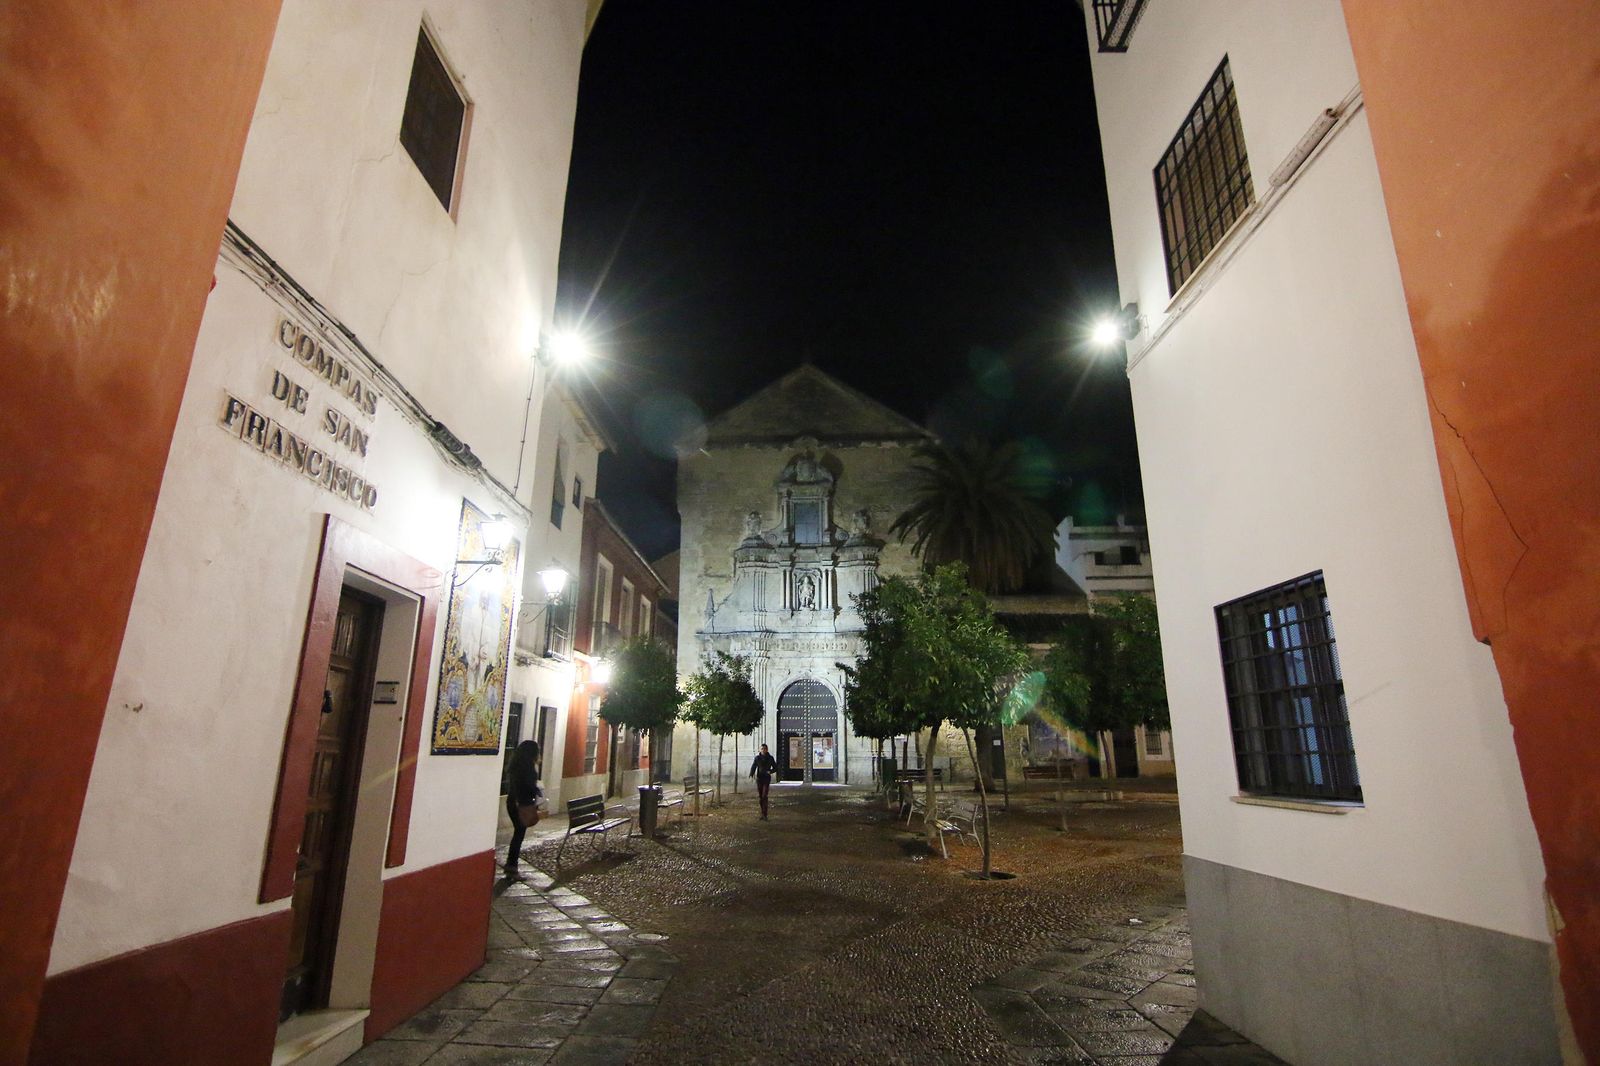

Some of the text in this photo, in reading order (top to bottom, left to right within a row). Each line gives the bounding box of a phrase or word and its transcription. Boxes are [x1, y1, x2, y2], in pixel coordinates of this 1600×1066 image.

[272, 369, 369, 457] DE SAN
[279, 318, 378, 415] COMPAS
[223, 396, 377, 507] FRANCISCO
